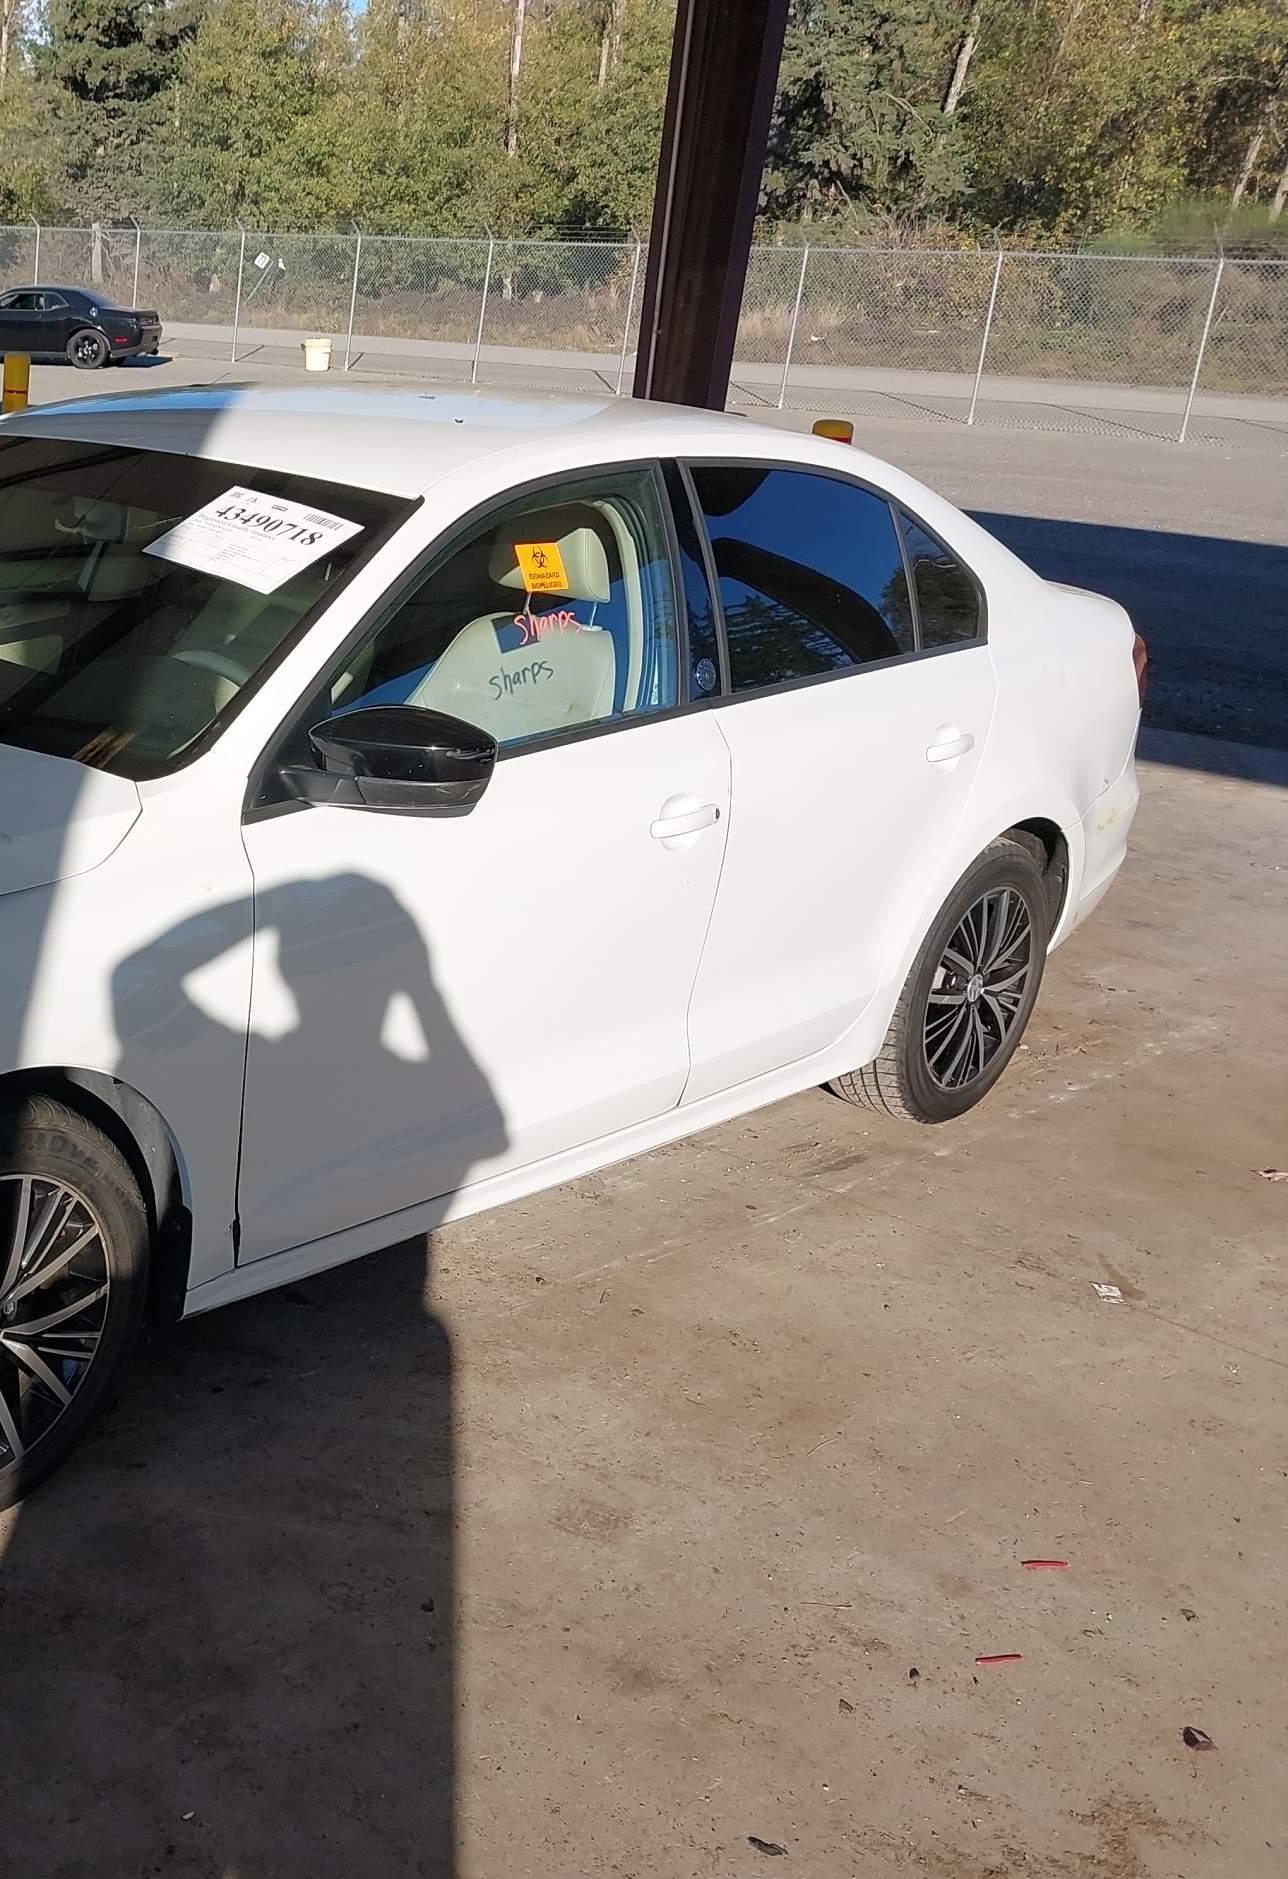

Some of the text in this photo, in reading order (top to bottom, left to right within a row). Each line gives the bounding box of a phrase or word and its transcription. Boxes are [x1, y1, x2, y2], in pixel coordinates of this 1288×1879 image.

[216, 506, 323, 546] 43490718
[514, 608, 583, 645] Sharps
[489, 661, 554, 700] Sharps
